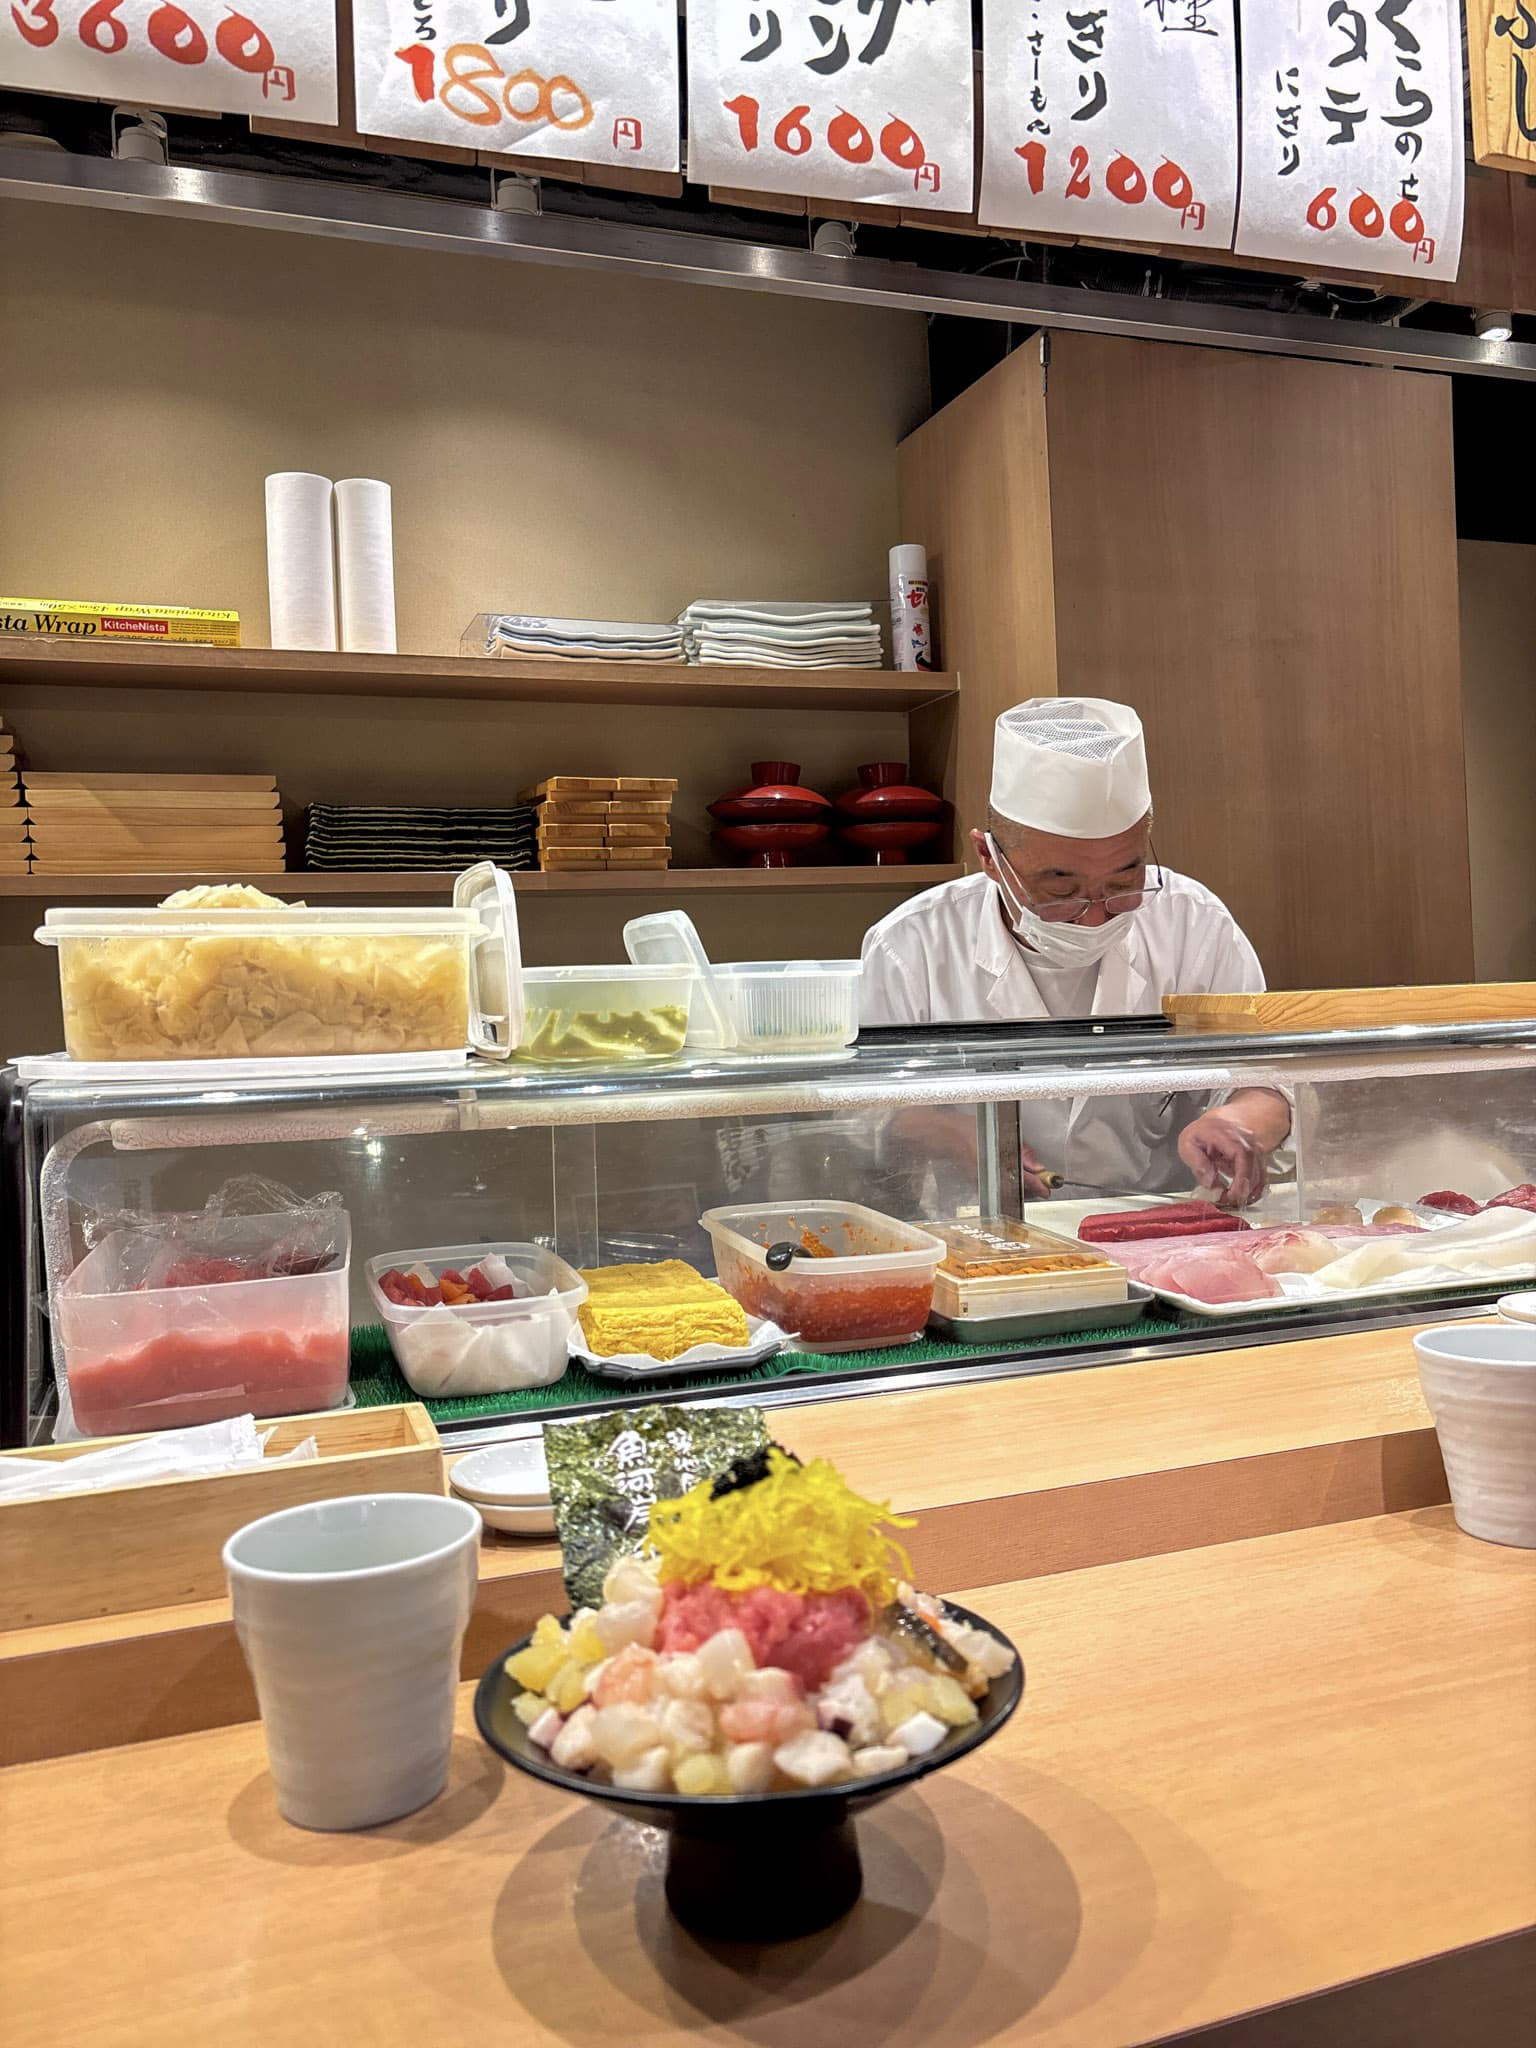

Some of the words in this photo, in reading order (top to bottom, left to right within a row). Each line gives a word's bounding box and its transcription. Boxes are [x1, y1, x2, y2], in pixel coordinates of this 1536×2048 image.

[724, 95, 941, 192] 1600円
[1015, 140, 1205, 230] 1200円
[1307, 187, 1435, 264] 600円
[34, 614, 97, 635] Wrap
[103, 620, 166, 632] KitcheNista
